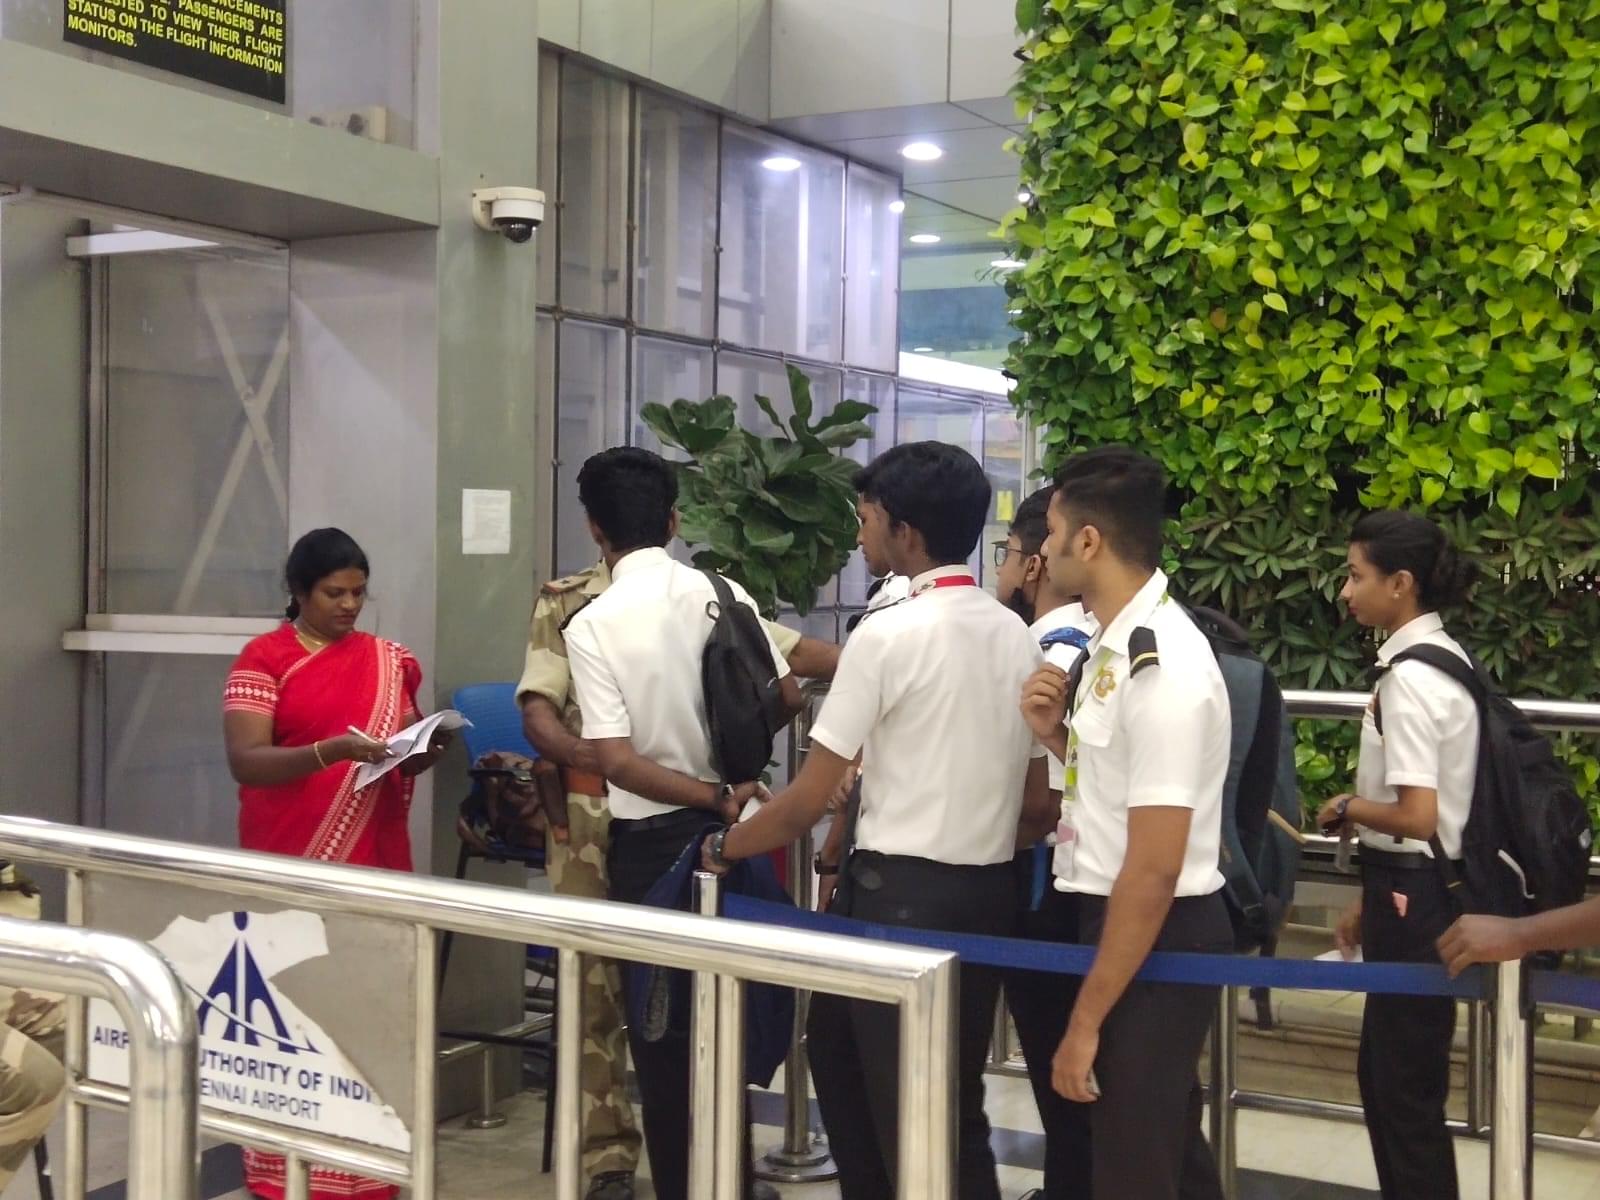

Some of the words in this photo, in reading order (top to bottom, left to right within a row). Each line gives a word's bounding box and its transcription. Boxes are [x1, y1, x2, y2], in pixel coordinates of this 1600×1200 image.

[67, 14, 138, 47] MONITORS.
[150, 4, 167, 21] TO
[172, 10, 202, 32] VIEW
[207, 22, 240, 45] THEIR
[245, 35, 283, 57] FLIGHT
[178, 0, 255, 32] PASSENGERS
[260, 24, 283, 42] ARE
[212, 0, 283, 25] NCEMENTS
[68, 0, 116, 23] STATUS
[119, 12, 138, 30] ON
[139, 18, 164, 38] THE
[166, 26, 207, 51] FLIGHT
[209, 39, 283, 74] INFORMATION
[93, 1025, 130, 1050] AIRP
[199, 1049, 291, 1085] UTHORITY
[298, 1069, 323, 1091] OF
[330, 1074, 371, 1103] INDI
[200, 1077, 247, 1105] ENNAI
[251, 1089, 322, 1121] AIRPORT
